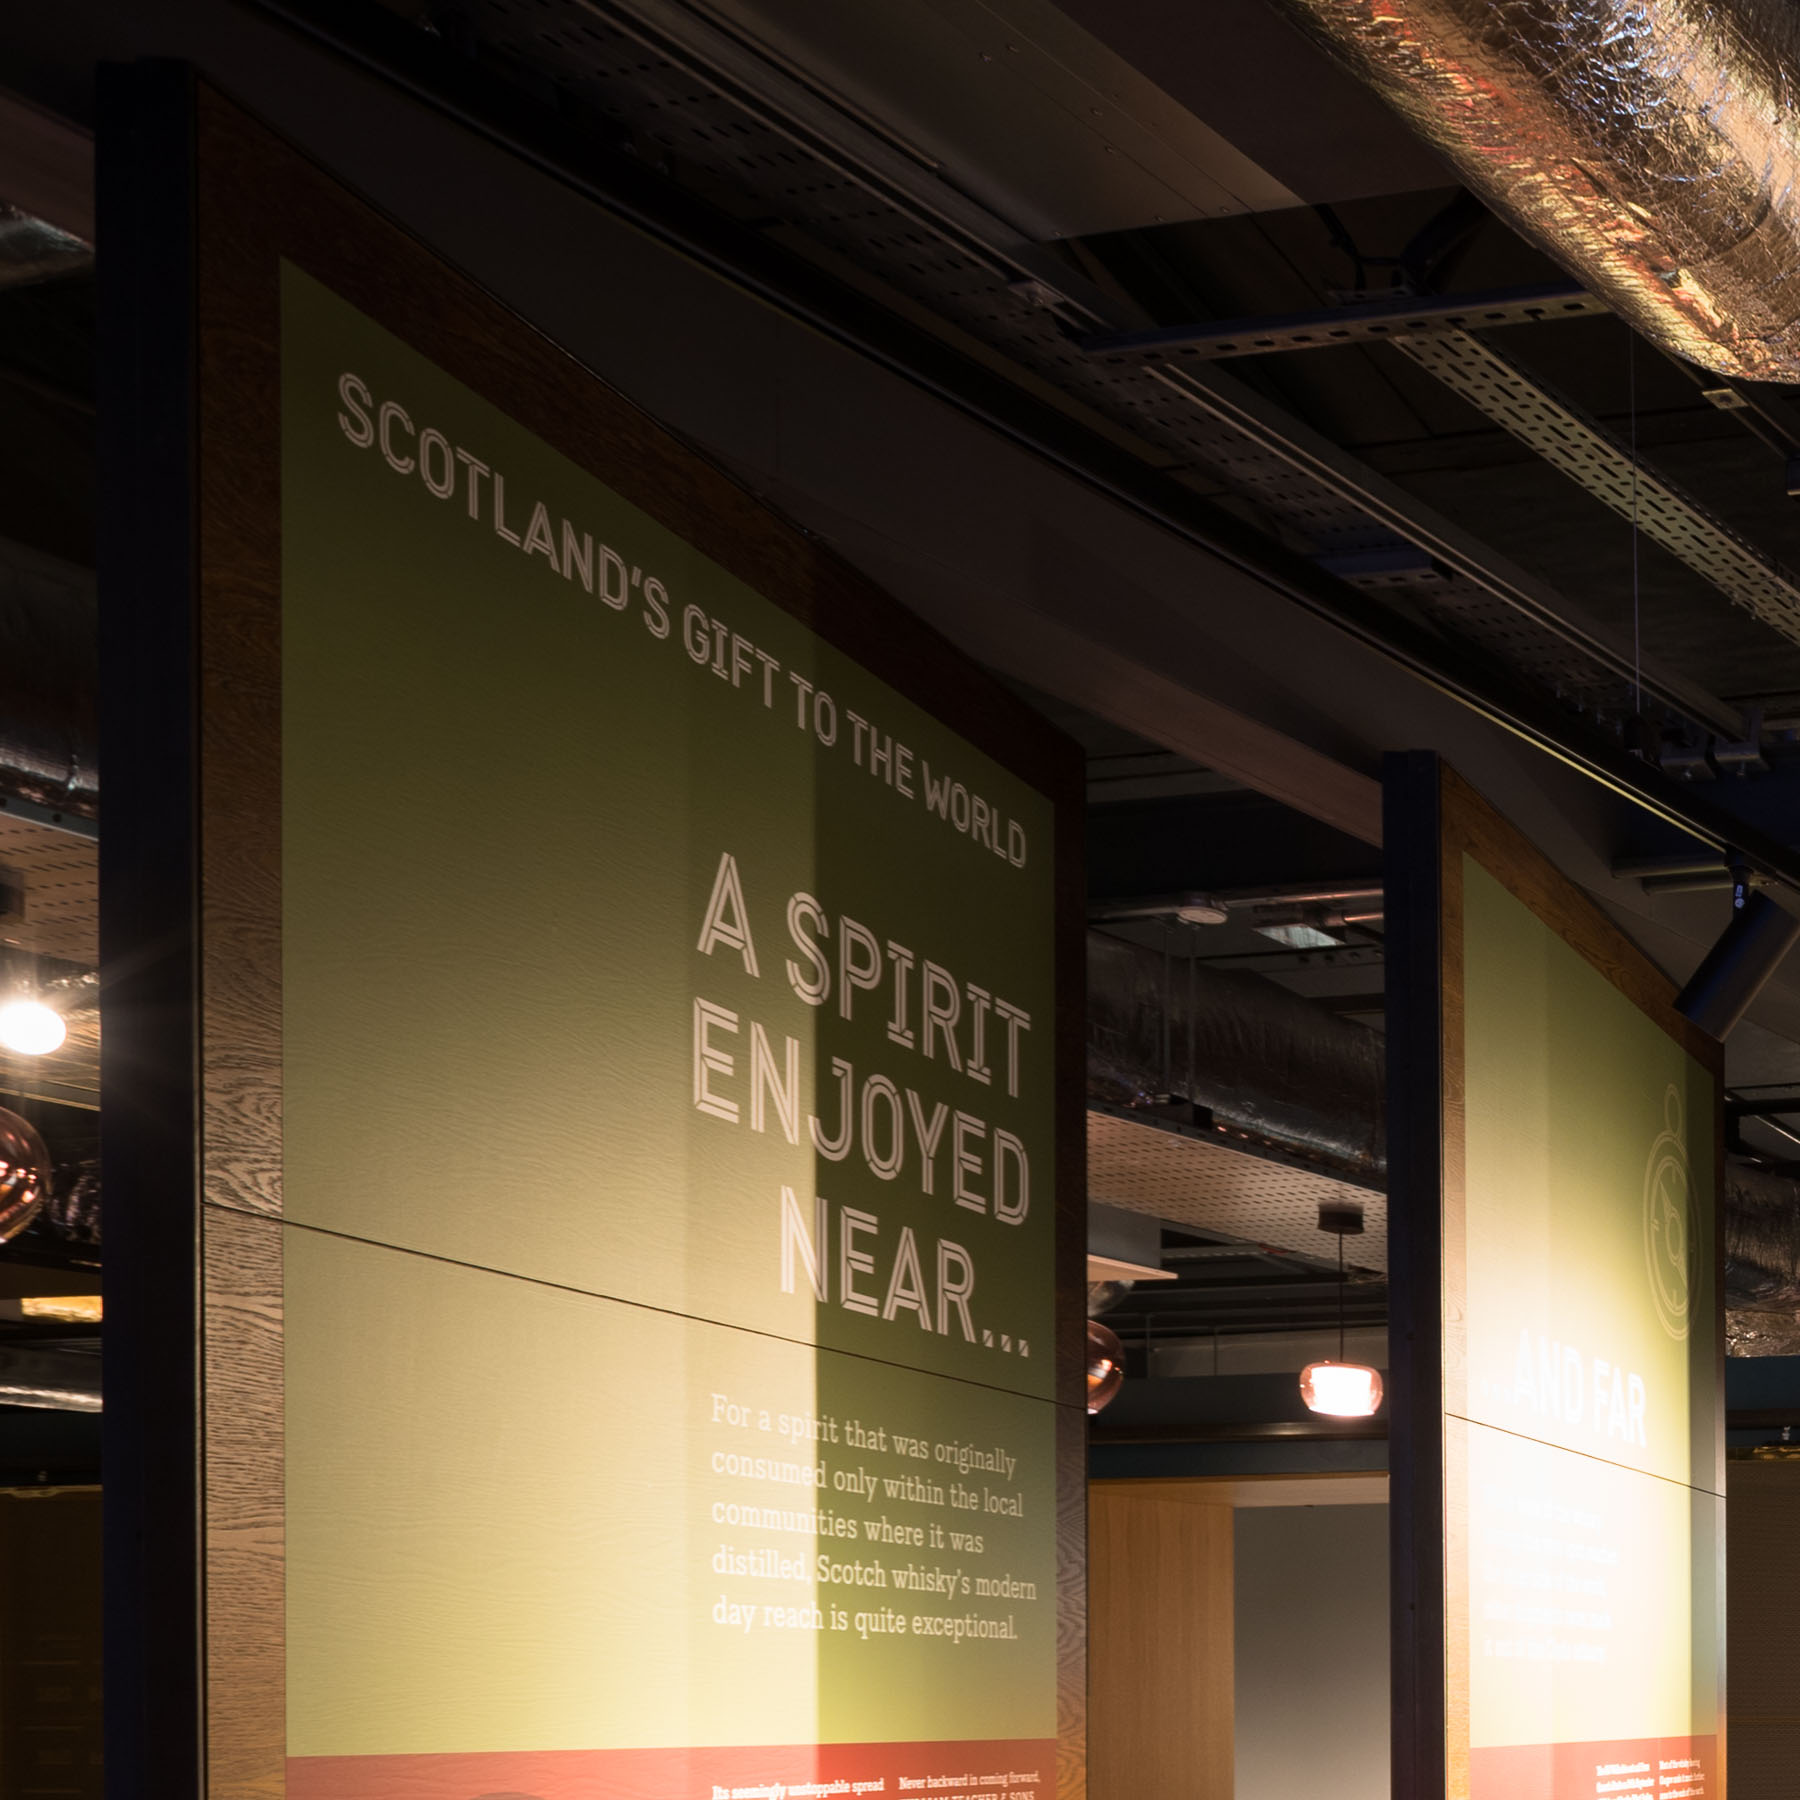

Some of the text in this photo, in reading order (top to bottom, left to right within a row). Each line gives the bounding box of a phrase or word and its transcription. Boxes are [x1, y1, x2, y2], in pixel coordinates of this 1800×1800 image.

[338, 372, 1026, 868] SCOTLAND'S GIFT TO THE WORLD
[696, 852, 1031, 1099] A SPIRIT
[693, 996, 1029, 1226] ENJOYED
[780, 1185, 1029, 1354] NEAR...
[712, 1393, 1016, 1481] For a spirit that was originally
[1593, 1356, 1648, 1448] FAR
[712, 1451, 1023, 1517] consumed only within the local
[712, 1501, 984, 1553] communities where it was
[712, 1545, 1037, 1601] distilled, Scotch whisky's modern
[712, 1596, 1018, 1643] day reach is quite exceptional.
[899, 1776, 925, 1790] Never
[969, 1773, 978, 1786] in
[979, 1772, 1008, 1788] coming
